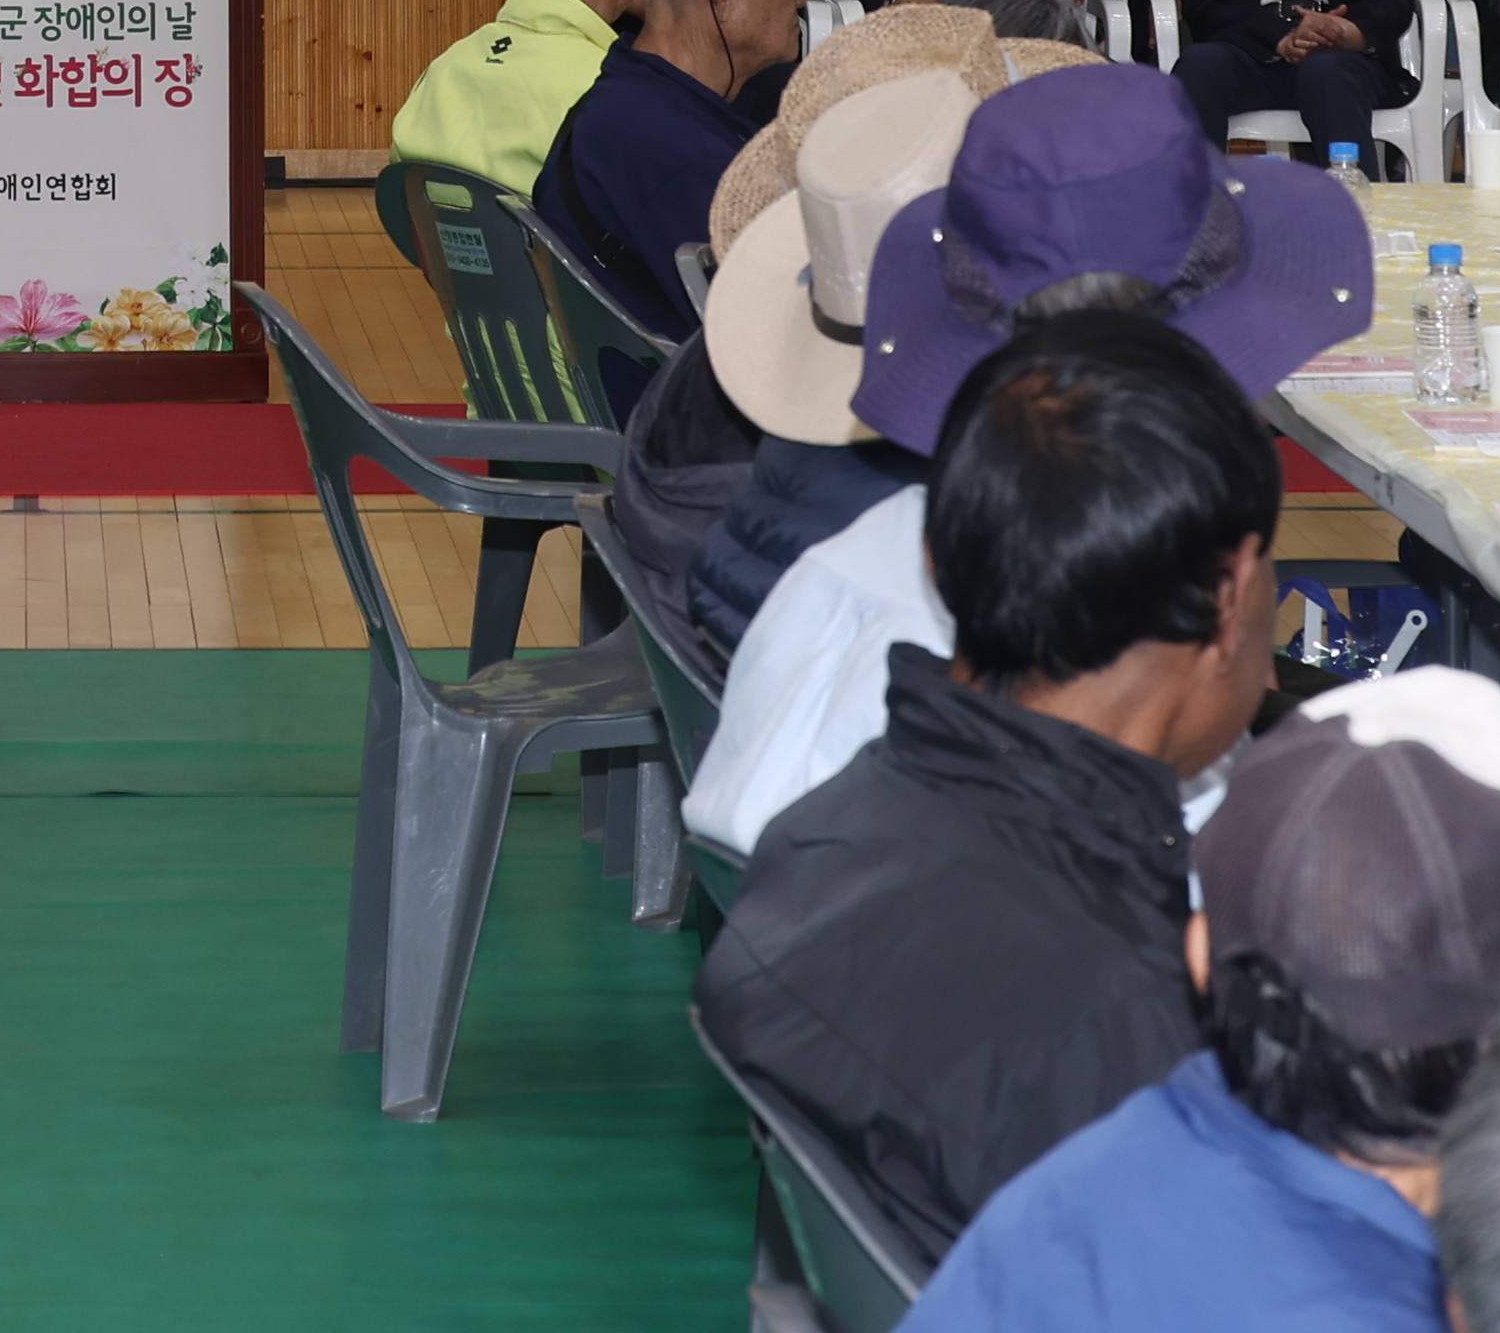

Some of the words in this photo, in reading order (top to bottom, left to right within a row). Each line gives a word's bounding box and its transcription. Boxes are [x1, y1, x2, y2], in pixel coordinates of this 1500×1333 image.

[33, 2, 157, 42] 장애인의
[165, 2, 197, 41] 날
[13, 52, 143, 108] 화합의
[154, 53, 200, 108] 장
